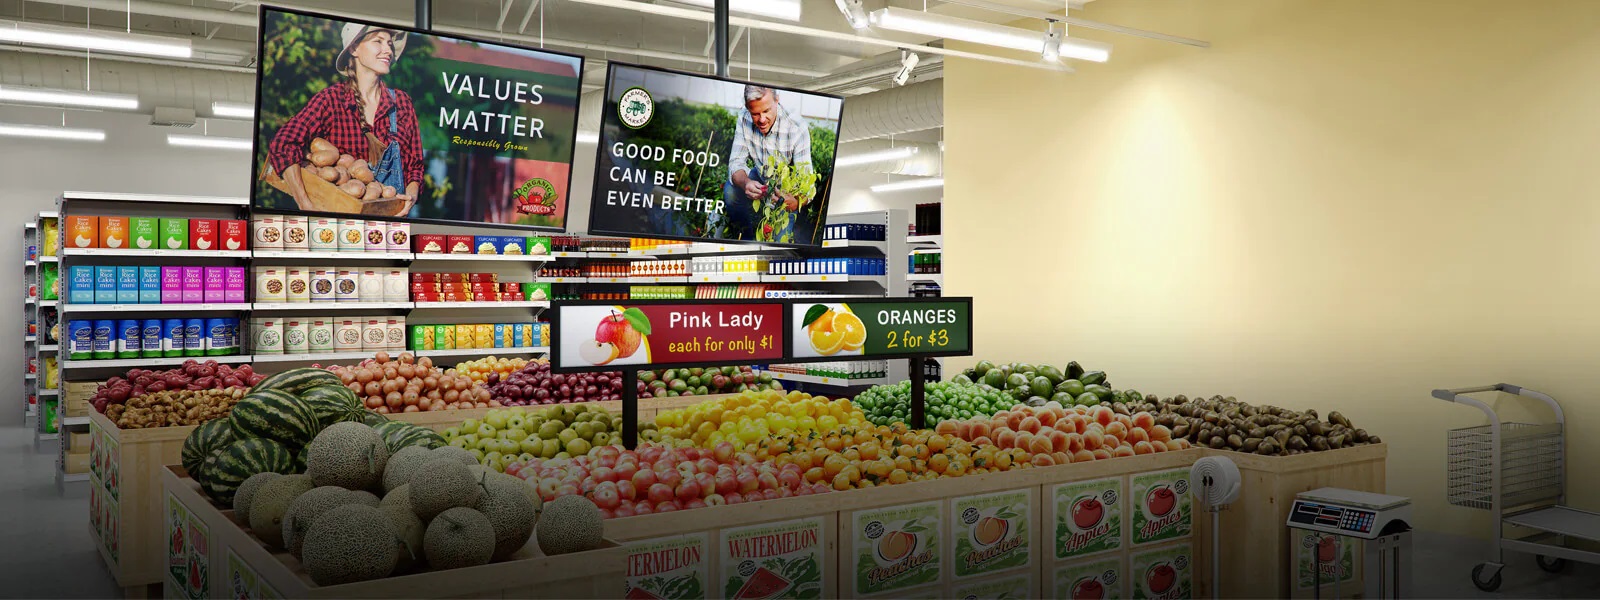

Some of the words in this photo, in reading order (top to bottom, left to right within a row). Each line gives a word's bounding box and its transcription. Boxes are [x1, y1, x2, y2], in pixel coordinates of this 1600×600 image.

[442, 72, 543, 105] VALUES
[439, 106, 544, 138] MATTER
[624, 114, 646, 124] MARKET
[452, 136, 500, 149] Responsibly
[504, 141, 528, 151] Grown
[612, 142, 665, 162] GOOD
[672, 148, 720, 167] FOOD
[522, 180, 552, 192] ORGANIC
[610, 166, 646, 184] CAN
[654, 170, 676, 186] BE
[522, 204, 550, 212] PRODUCTS
[607, 190, 654, 208] EVEN
[661, 195, 725, 214] BETTER
[670, 311, 711, 328] Pink
[719, 311, 763, 330] Lady
[878, 309, 956, 325] ORANGES
[669, 337, 700, 352] each
[705, 336, 724, 351] for
[728, 336, 755, 354] only
[760, 335, 773, 349] $1
[887, 331, 898, 348] 2
[903, 330, 922, 348] for
[928, 329, 949, 346] $3
[1141, 511, 1181, 538] Apples
[729, 529, 817, 558] WATERMELON
[1066, 523, 1109, 552] Apples
[627, 544, 701, 576] TERMELON
[966, 535, 1022, 568] Peaches
[868, 549, 933, 586] Peaches
